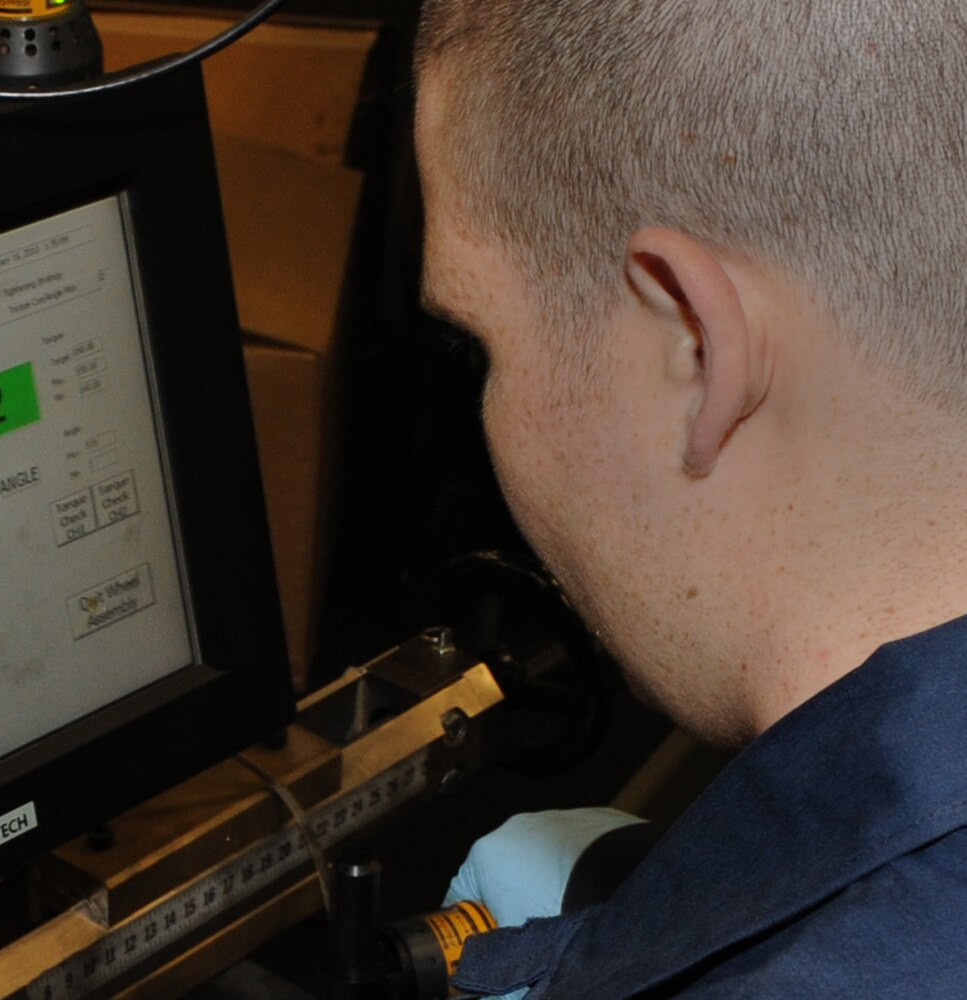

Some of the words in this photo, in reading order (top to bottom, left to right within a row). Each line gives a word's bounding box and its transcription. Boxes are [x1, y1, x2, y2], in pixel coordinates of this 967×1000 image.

[0, 466, 40, 495] ANGLE
[84, 959, 96, 977] 10
[105, 947, 116, 966] 11
[124, 934, 137, 954] 12
[144, 922, 157, 941] 13
[163, 910, 176, 929] 14
[183, 899, 196, 918] 15
[203, 887, 216, 907] 16
